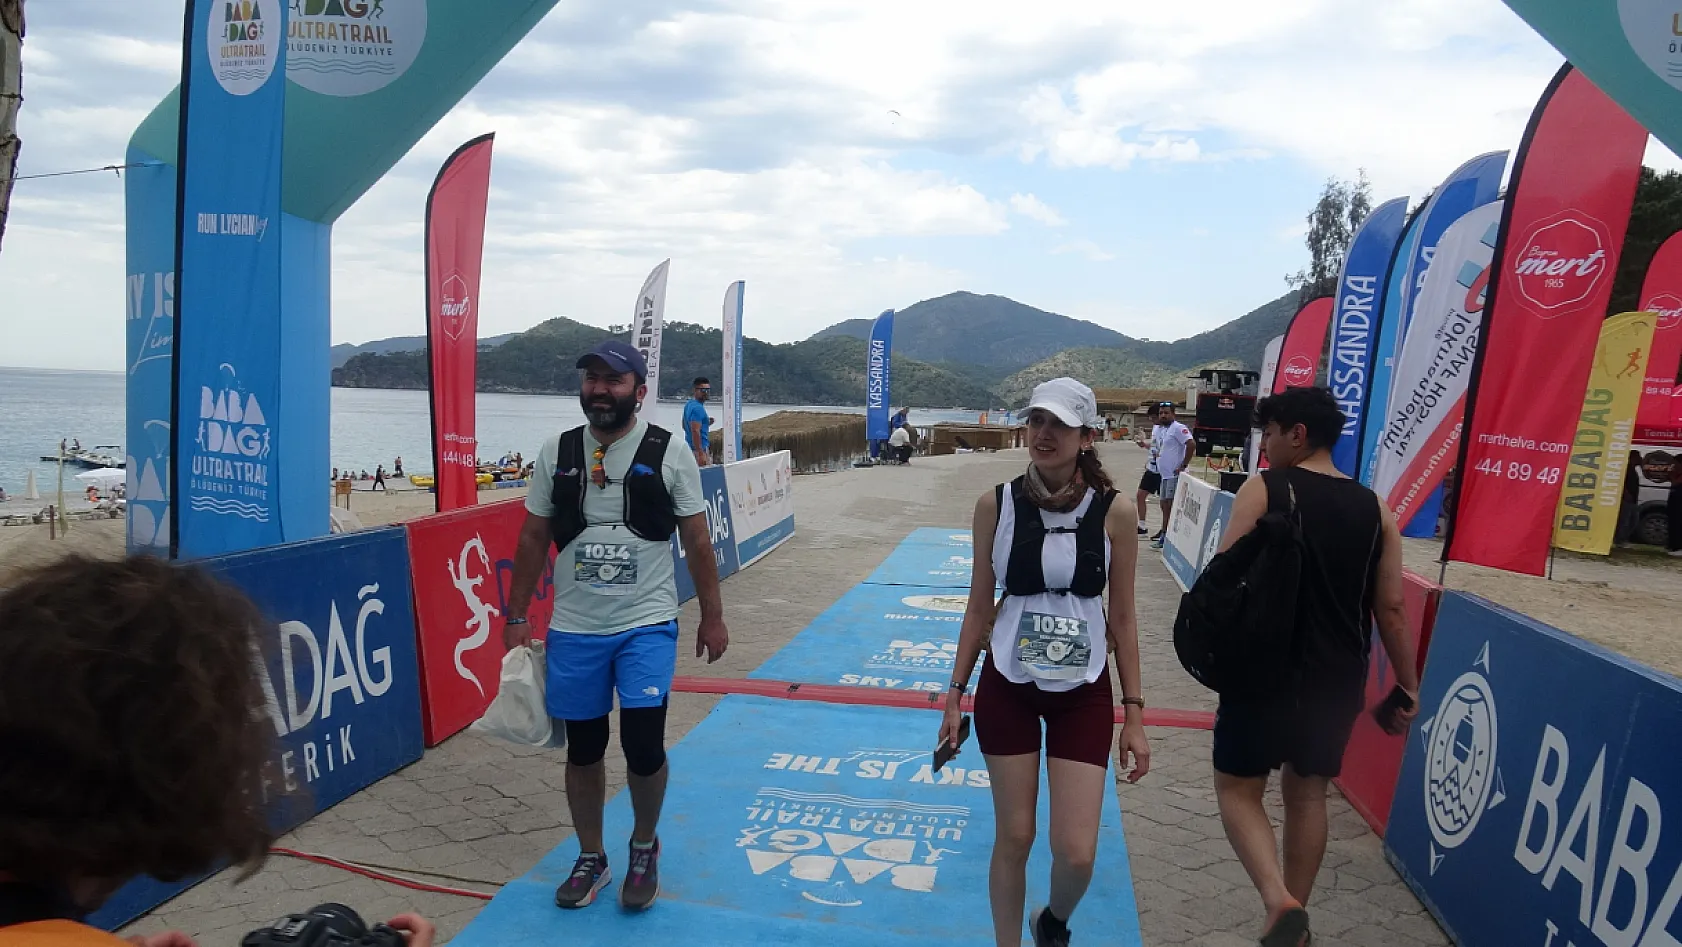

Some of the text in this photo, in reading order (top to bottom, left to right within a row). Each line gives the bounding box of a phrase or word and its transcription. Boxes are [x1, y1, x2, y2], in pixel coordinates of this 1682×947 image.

[287, 21, 392, 43] ULTRATRAIL
[221, 44, 266, 58] ULTRATRAIL
[198, 213, 217, 234] RUN
[1515, 249, 1605, 276] mert
[869, 340, 885, 408] KASSANDRA
[200, 386, 266, 425] BABA
[1507, 462, 1532, 481] 89
[1536, 467, 1560, 484] 48
[1600, 417, 1633, 506] ULTRATRAIL
[585, 544, 630, 560] 1034
[1033, 615, 1079, 636] 1033
[763, 753, 990, 788] SKY IS THE
[746, 807, 962, 841] ULTRATRAIL
[768, 829, 916, 863] DAG
[746, 849, 938, 892] BABA
